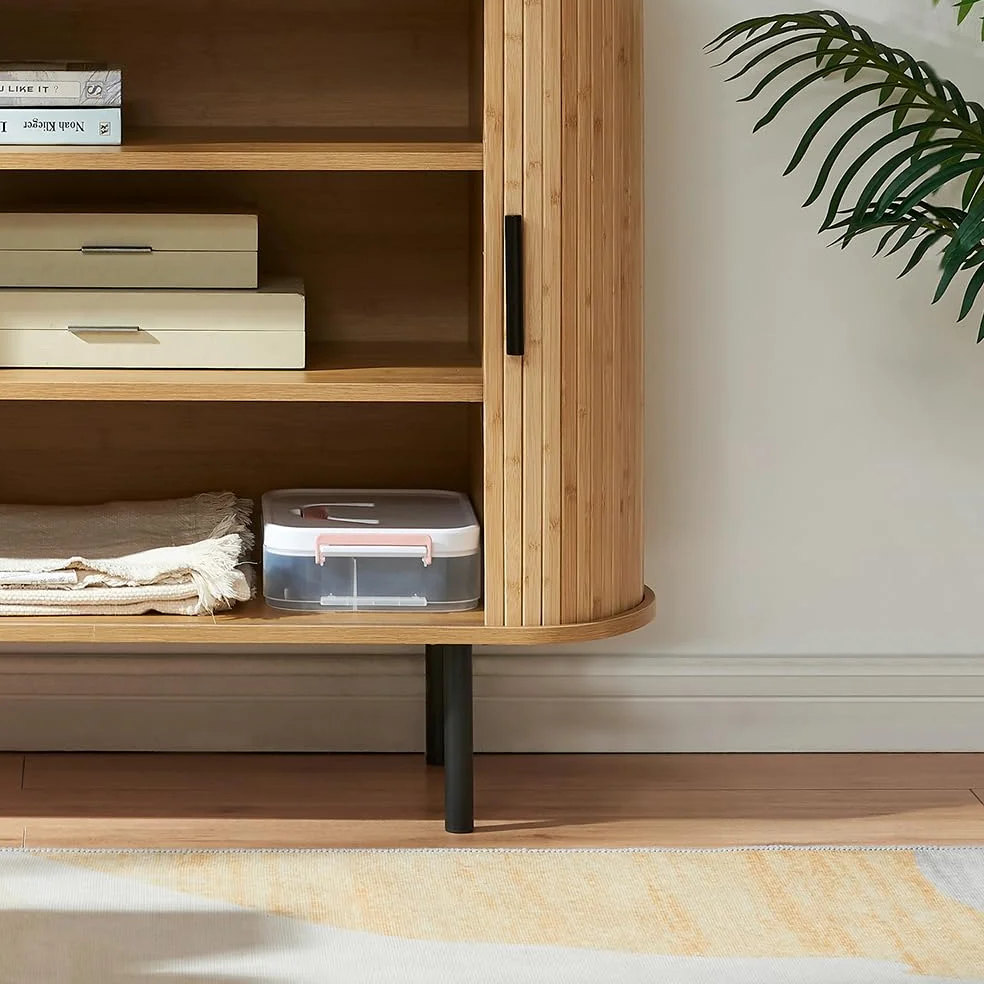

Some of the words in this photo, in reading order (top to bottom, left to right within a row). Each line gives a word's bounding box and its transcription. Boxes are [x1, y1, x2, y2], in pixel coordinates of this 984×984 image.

[38, 85, 49, 93] IT
[23, 118, 56, 132] Klieger
[58, 121, 85, 132] Noah
